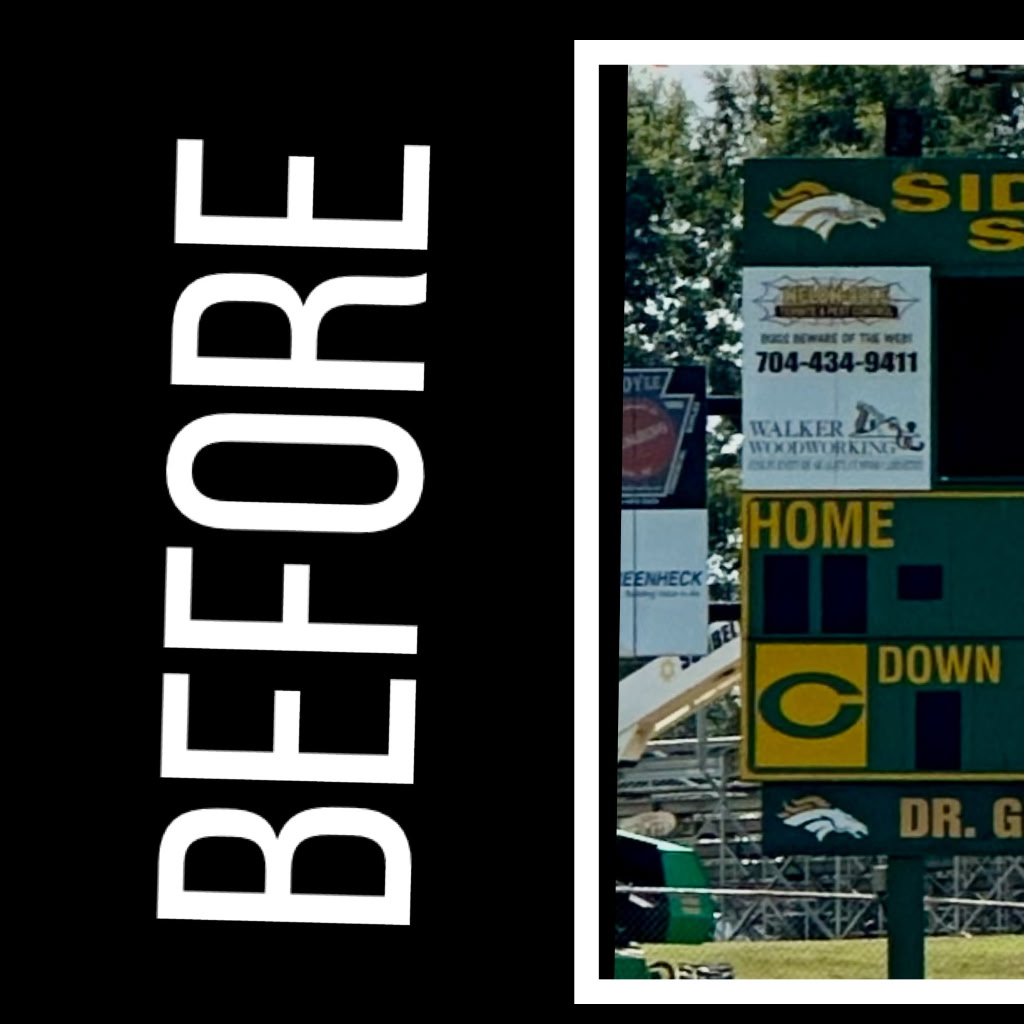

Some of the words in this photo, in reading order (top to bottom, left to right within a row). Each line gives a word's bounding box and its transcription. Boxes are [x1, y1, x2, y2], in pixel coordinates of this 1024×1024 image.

[756, 350, 918, 373] 704-434-9411
[750, 420, 844, 437] WALKER
[749, 440, 897, 455] WOODWORKING
[748, 501, 896, 549] HOME
[621, 570, 703, 587] EENHECK
[879, 644, 1002, 685] DOWN
[758, 672, 865, 740] C
[901, 798, 976, 838] DR.
